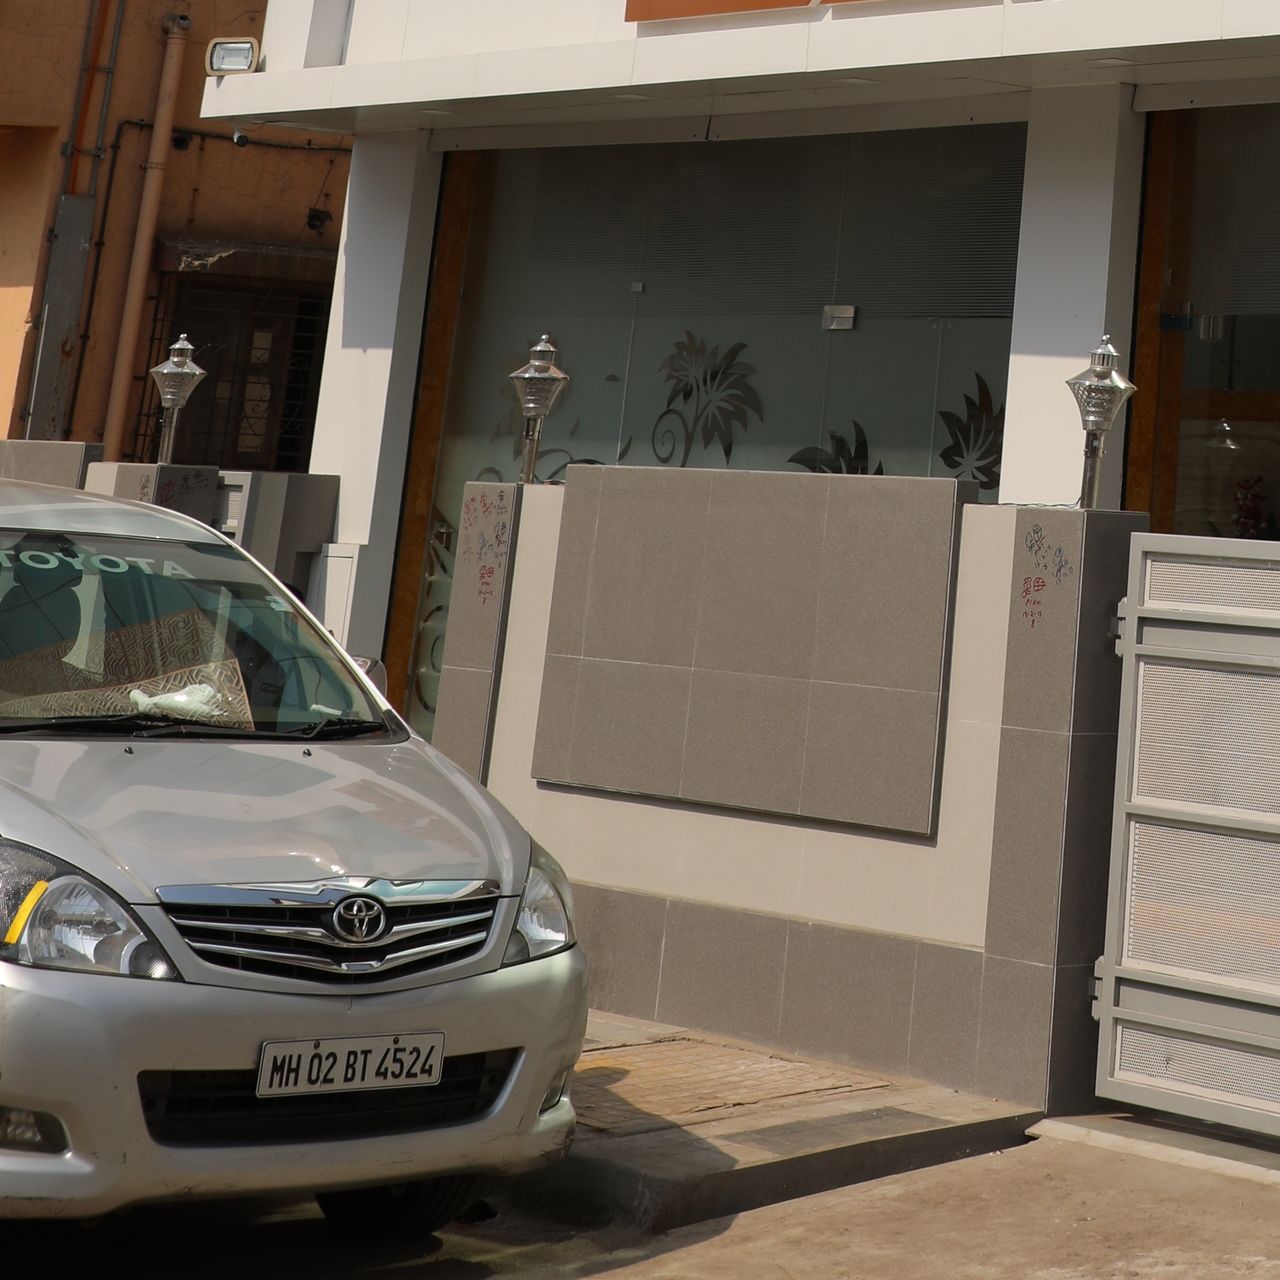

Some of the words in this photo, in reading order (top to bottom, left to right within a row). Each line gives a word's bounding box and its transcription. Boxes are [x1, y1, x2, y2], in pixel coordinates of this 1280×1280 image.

[268, 1053, 302, 1088] MH
[307, 1051, 338, 1086] 02
[343, 1048, 373, 1084] BT
[375, 1044, 436, 1081] 4524
